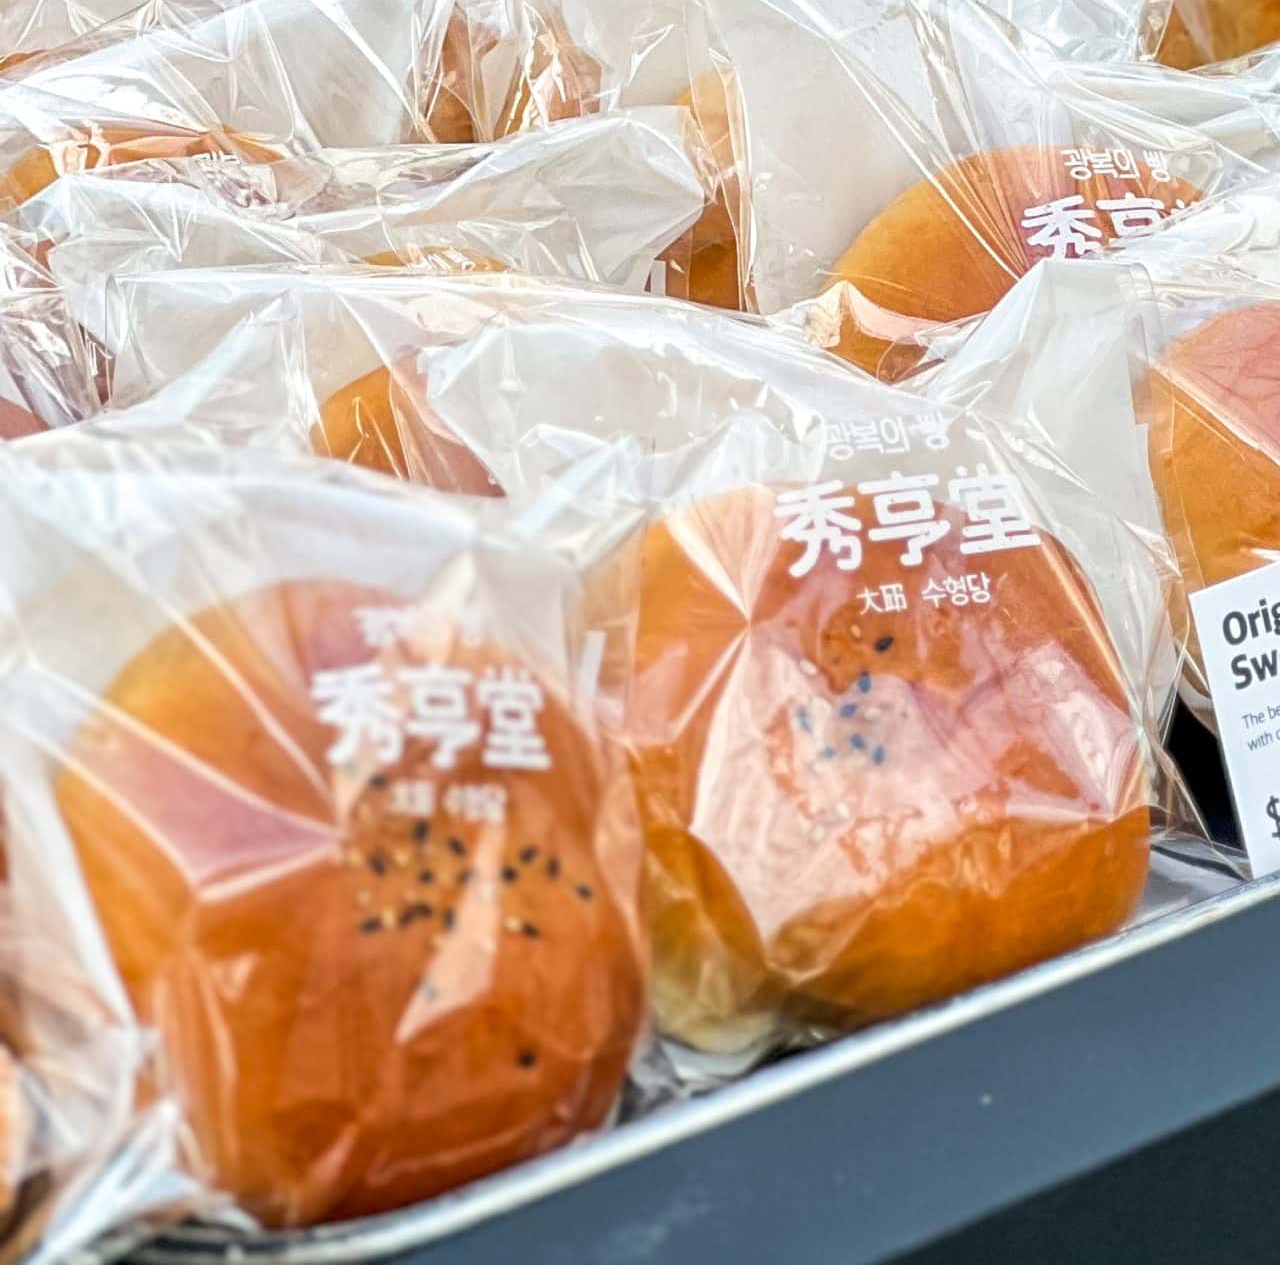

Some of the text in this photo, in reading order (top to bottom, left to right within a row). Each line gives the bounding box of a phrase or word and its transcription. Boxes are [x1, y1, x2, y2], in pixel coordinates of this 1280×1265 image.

[1061, 148, 1141, 181] 광복의
[1020, 192, 1199, 260] 秀亨
[774, 462, 1043, 578] 秀亨堂
[922, 572, 992, 609] 수형당
[1241, 711, 1266, 729] The
[1247, 730, 1274, 752] with
